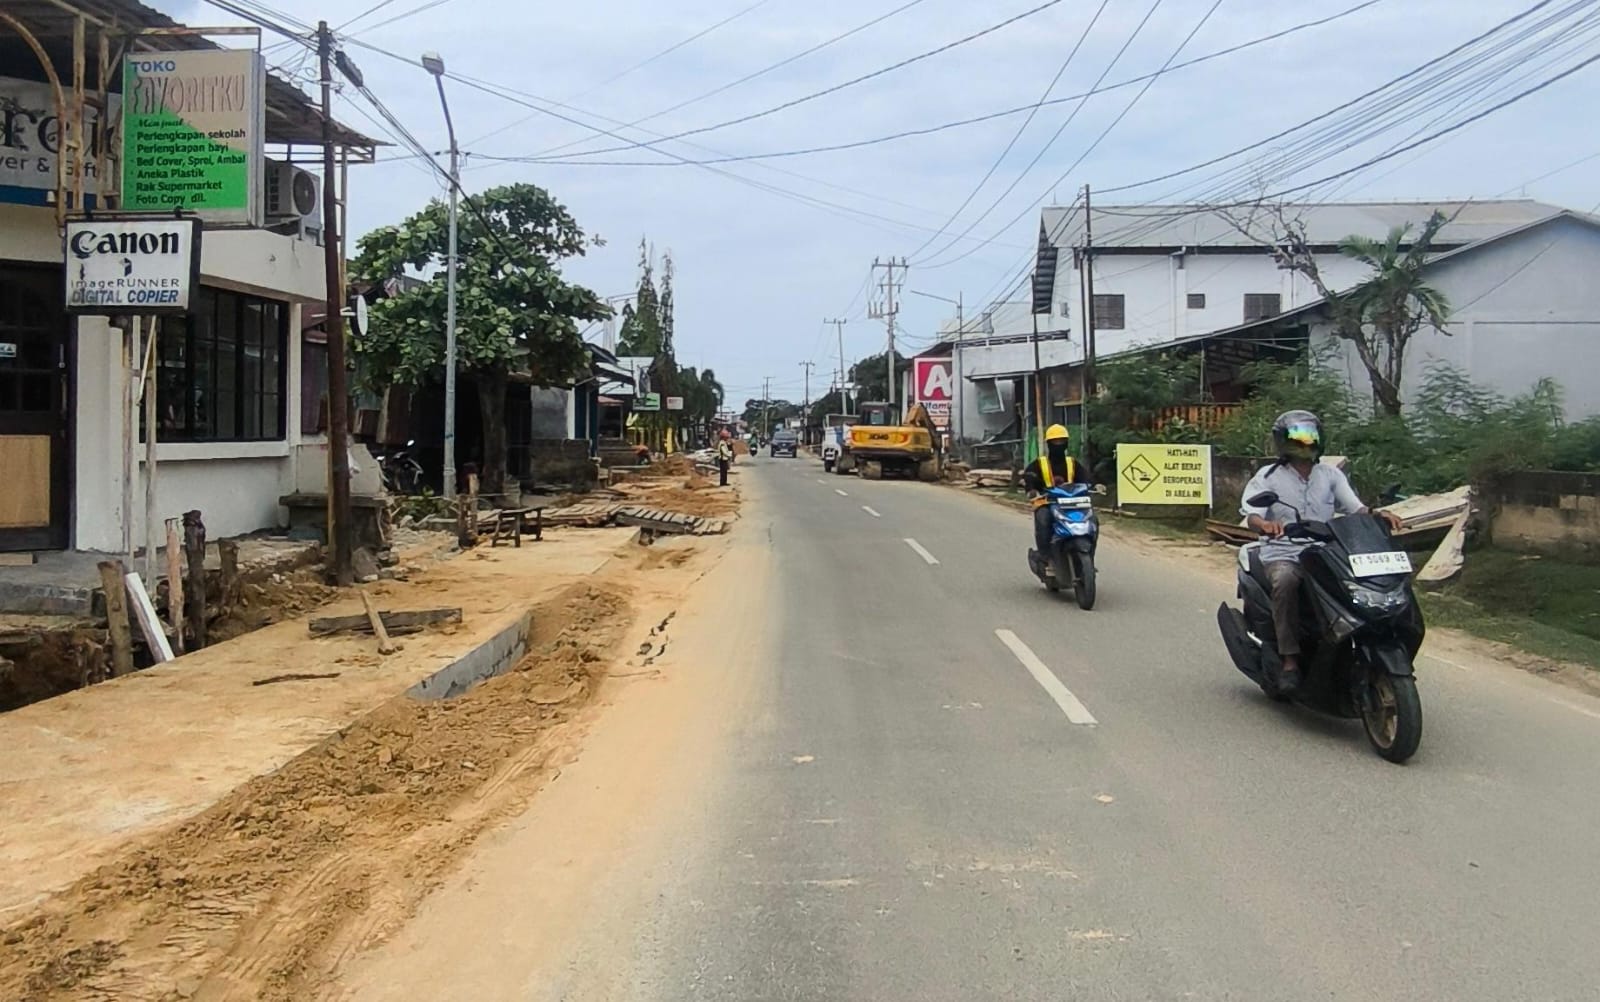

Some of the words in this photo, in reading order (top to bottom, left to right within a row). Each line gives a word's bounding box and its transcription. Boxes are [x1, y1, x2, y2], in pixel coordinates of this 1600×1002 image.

[131, 60, 176, 72] TOKO
[137, 131, 205, 141] Perlengkapan
[208, 129, 246, 139] sekolah
[137, 143, 205, 155] Perlengkapan
[208, 142, 229, 153] bayi
[36, 157, 50, 173] &
[137, 157, 154, 166] Bed
[156, 156, 185, 167] Cover,
[217, 155, 246, 164] Ambal
[137, 169, 168, 179] Aneka
[171, 168, 204, 178] Plastik
[136, 182, 155, 192] Rak
[158, 180, 222, 192] Supermarket
[136, 194, 158, 204] Foto
[161, 193, 186, 205] Copy
[71, 231, 179, 256] Canon
[71, 278, 179, 288] imageRUNNER
[72, 290, 122, 304] DIGITAL
[127, 290, 179, 303] COPIER
[1167, 448, 1198, 457] HATI-HATI
[1163, 462, 1179, 470] ALAT
[1181, 462, 1202, 470] BERAT
